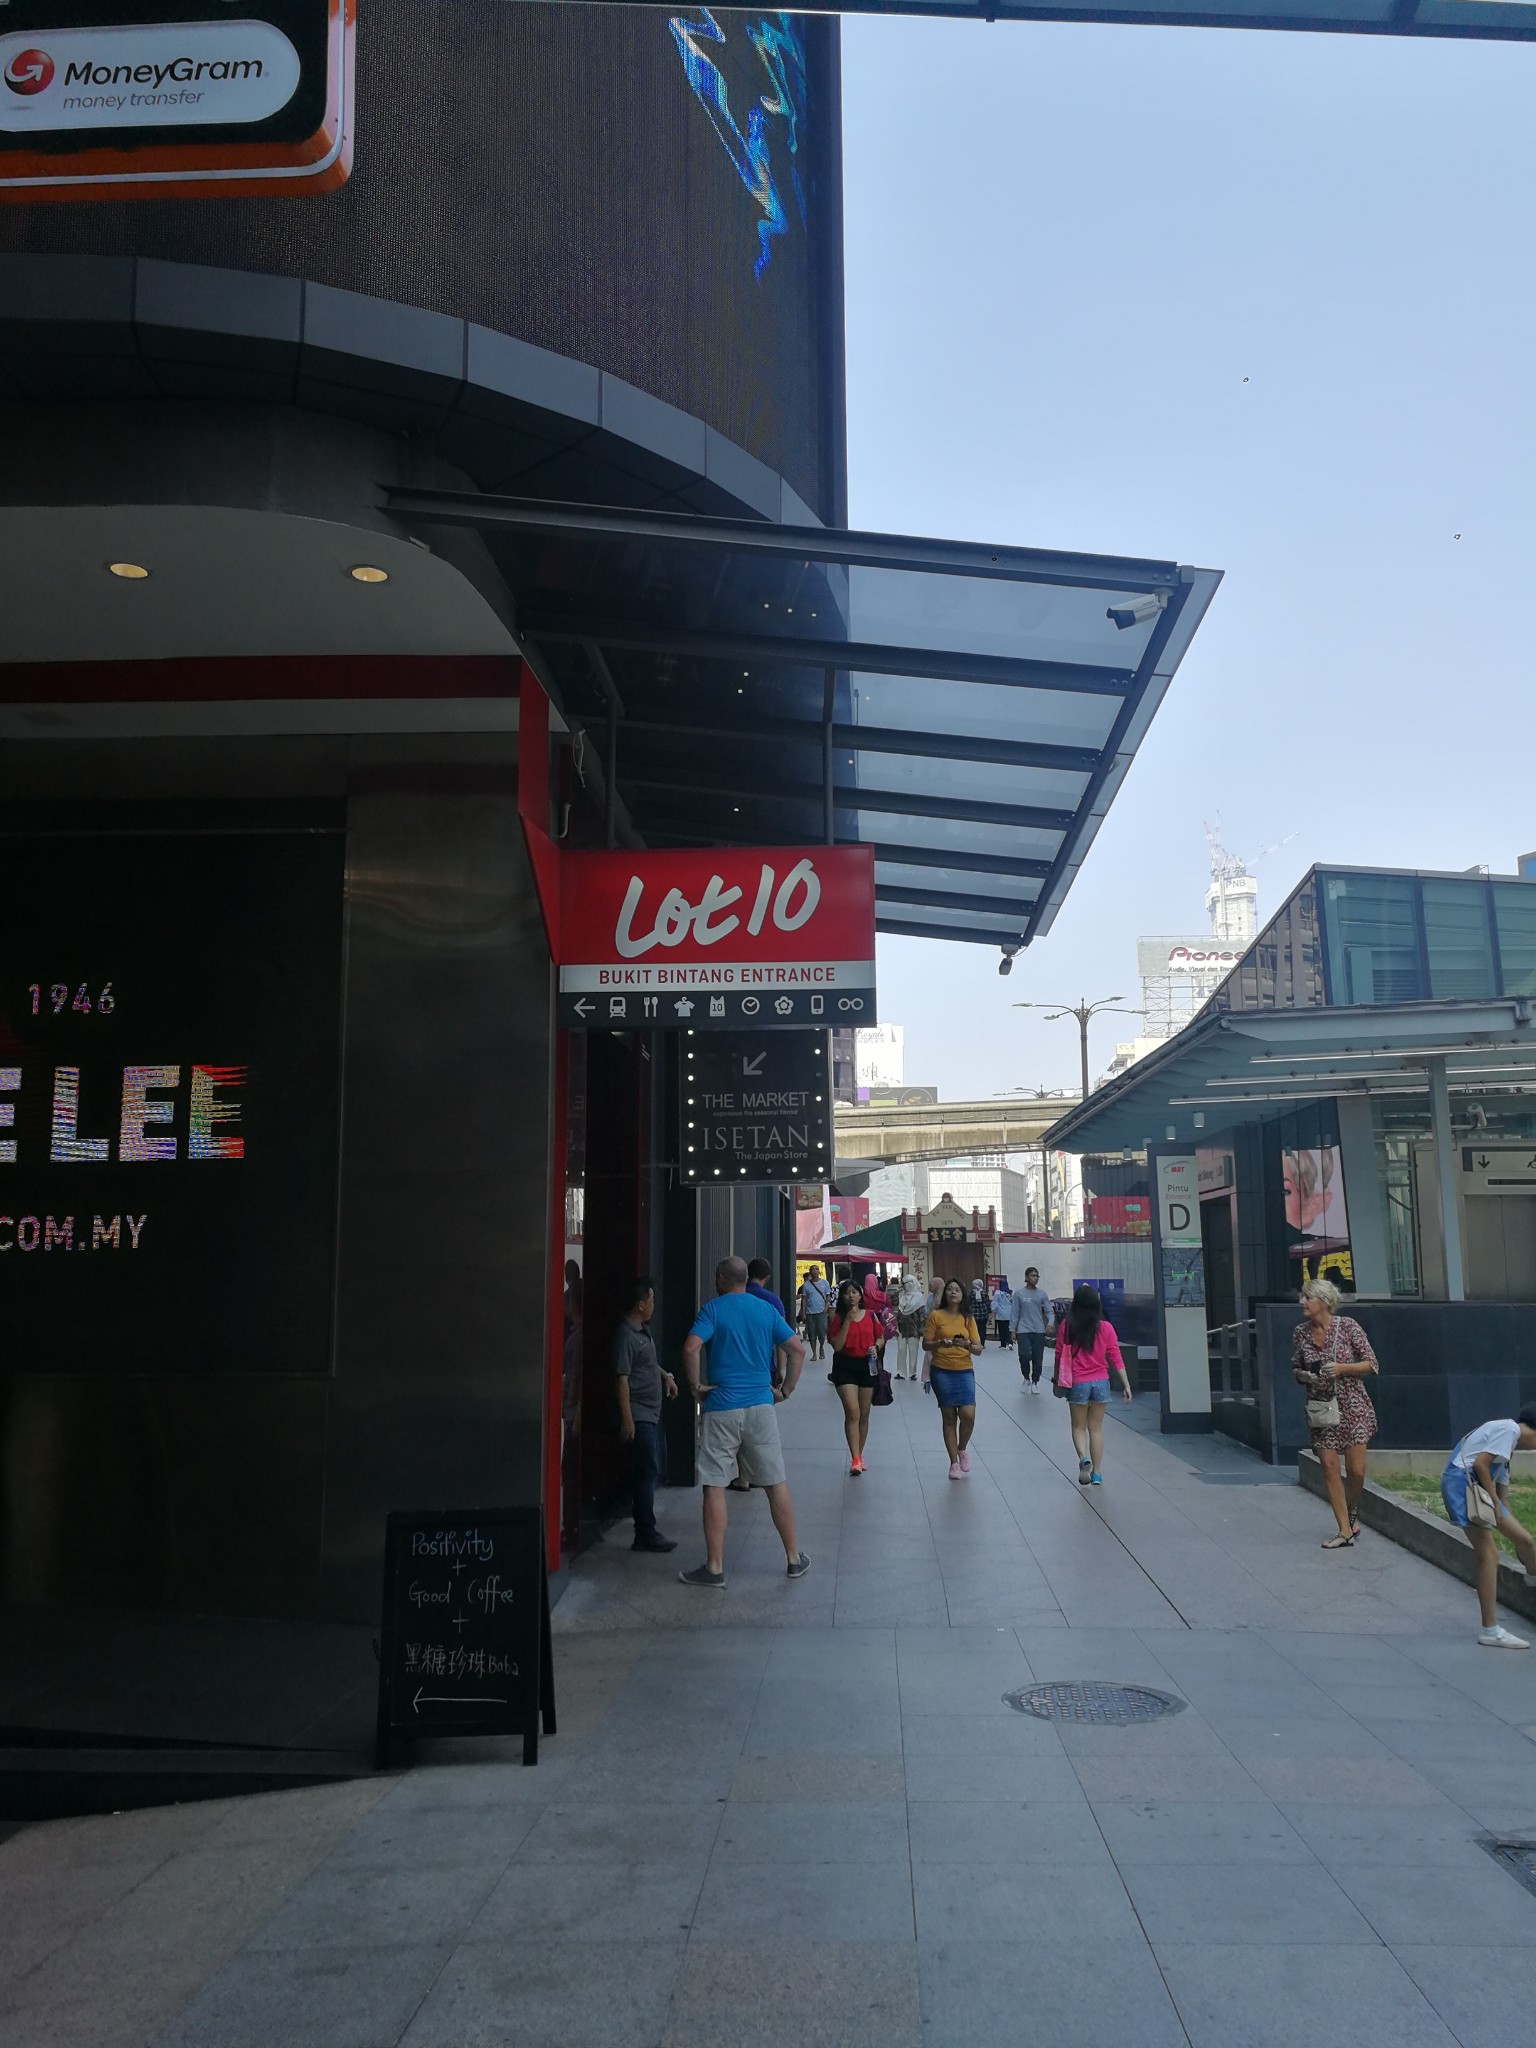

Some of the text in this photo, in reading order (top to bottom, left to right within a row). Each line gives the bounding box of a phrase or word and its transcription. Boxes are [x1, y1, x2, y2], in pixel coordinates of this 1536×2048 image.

[64, 57, 263, 89] MoneyGram
[63, 89, 205, 111] money transfer
[1225, 879, 1246, 888] PNB
[615, 858, 821, 958] Lot 10
[1168, 946, 1245, 961] Pionee
[599, 967, 835, 985] BUKIT BINTANG ENTRANCE
[28, 982, 116, 1015] 1946
[702, 1091, 809, 1109] THE MARKET
[703, 1124, 808, 1150] ISETAN
[735, 1150, 808, 1161] The Japan Store
[1167, 1184, 1189, 1192] Pintu
[1168, 1203, 1191, 1231] D
[412, 1528, 494, 1561] Positivity
[409, 1575, 514, 1614] Good Coffee
